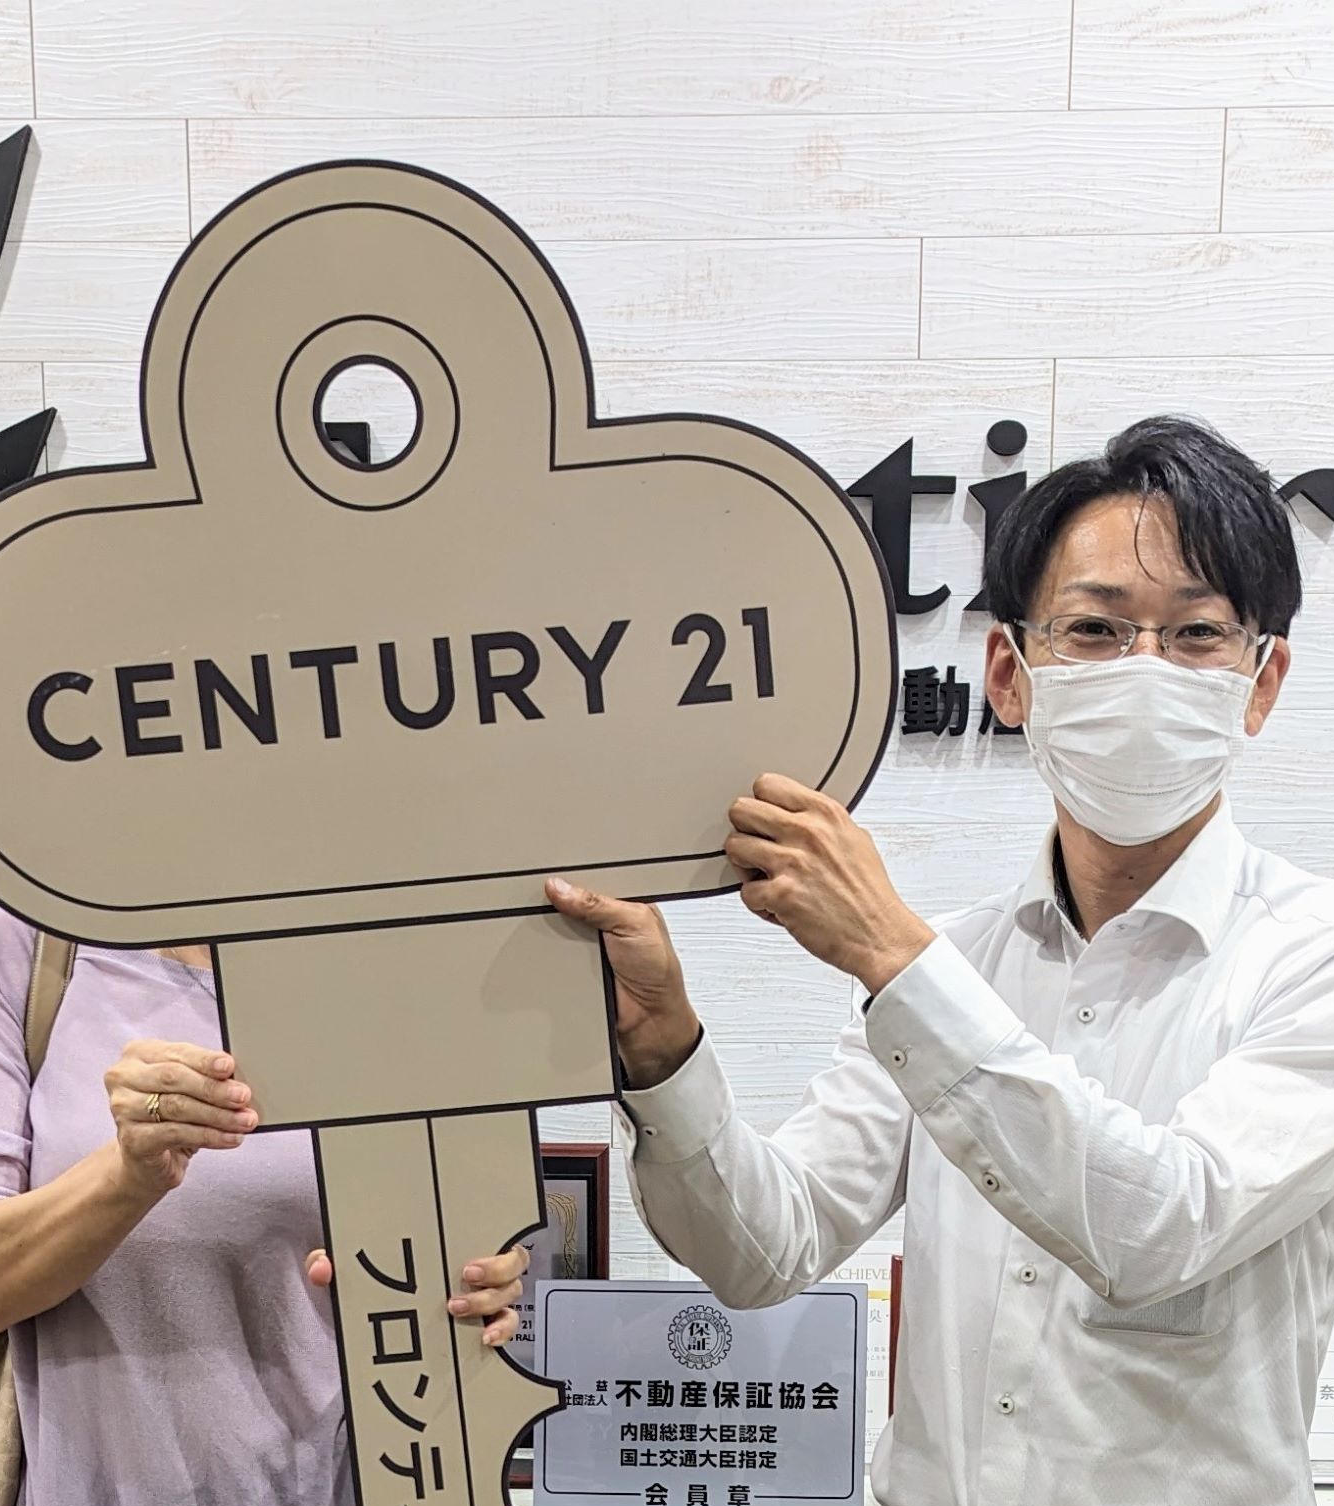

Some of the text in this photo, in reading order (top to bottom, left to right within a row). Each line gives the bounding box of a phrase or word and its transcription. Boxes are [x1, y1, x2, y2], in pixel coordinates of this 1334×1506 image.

[27, 606, 775, 762] CENTURY 21
[615, 1380, 840, 1410] 不動産保証協会
[620, 1423, 778, 1443] 内閣総理大臣認定
[620, 1449, 778, 1469] 国土交通大臣指定
